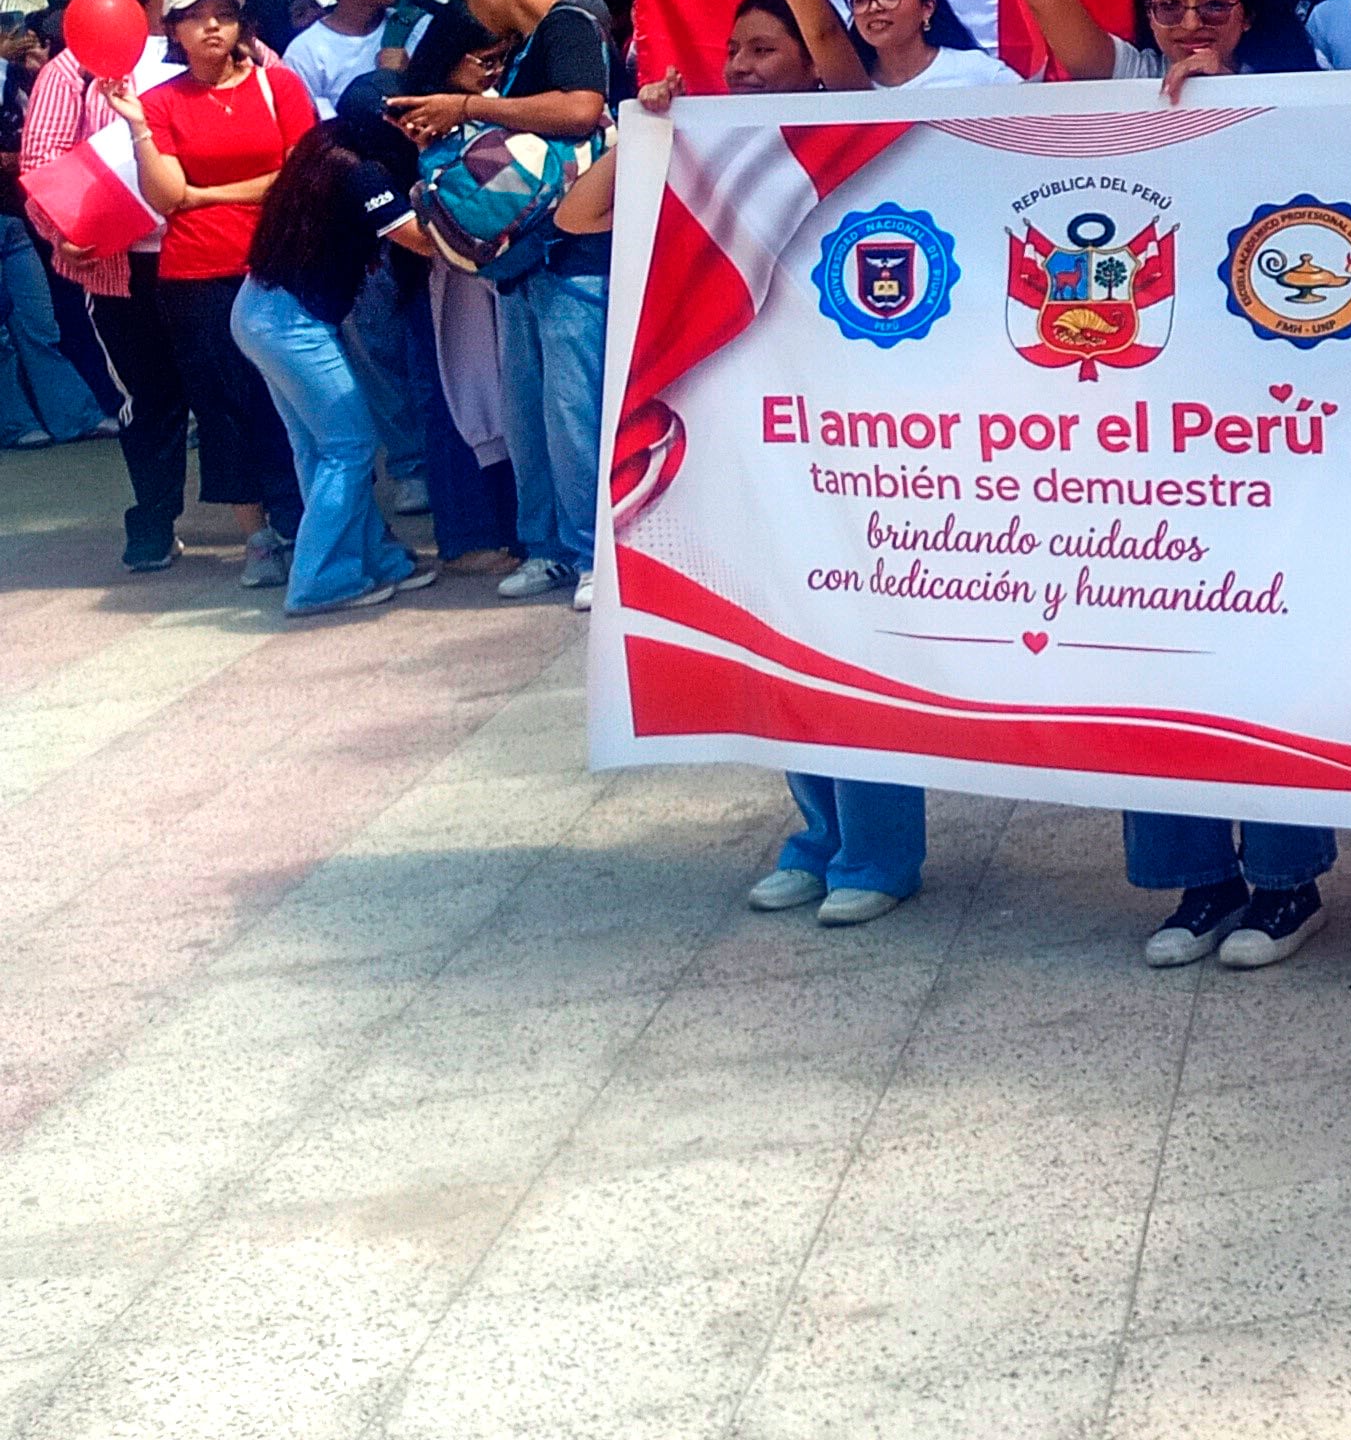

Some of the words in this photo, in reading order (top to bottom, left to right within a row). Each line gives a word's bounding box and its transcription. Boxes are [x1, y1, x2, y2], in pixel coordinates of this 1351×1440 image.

[1011, 176, 1096, 213] REPÚBLICA
[1100, 176, 1128, 193] DEL
[1131, 183, 1172, 210] PERÚ
[866, 220, 925, 241] NACIONAL
[927, 245, 939, 260] DE
[1280, 211, 1348, 232] PROFESIONAL
[1311, 320, 1336, 334] UNP
[762, 396, 810, 443] El
[820, 410, 961, 449] amor
[978, 413, 1078, 461] por
[1098, 401, 1149, 453] el
[1172, 398, 1324, 455] Perú
[811, 463, 960, 500] también
[975, 474, 1020, 502] se
[1033, 468, 1272, 508] demuestra
[866, 510, 1042, 556] brindando
[1048, 518, 1211, 561] cuidados
[807, 567, 863, 593] con
[870, 558, 1036, 604] dedicación
[1043, 578, 1068, 622] y
[1075, 565, 1290, 615] humanidad.
